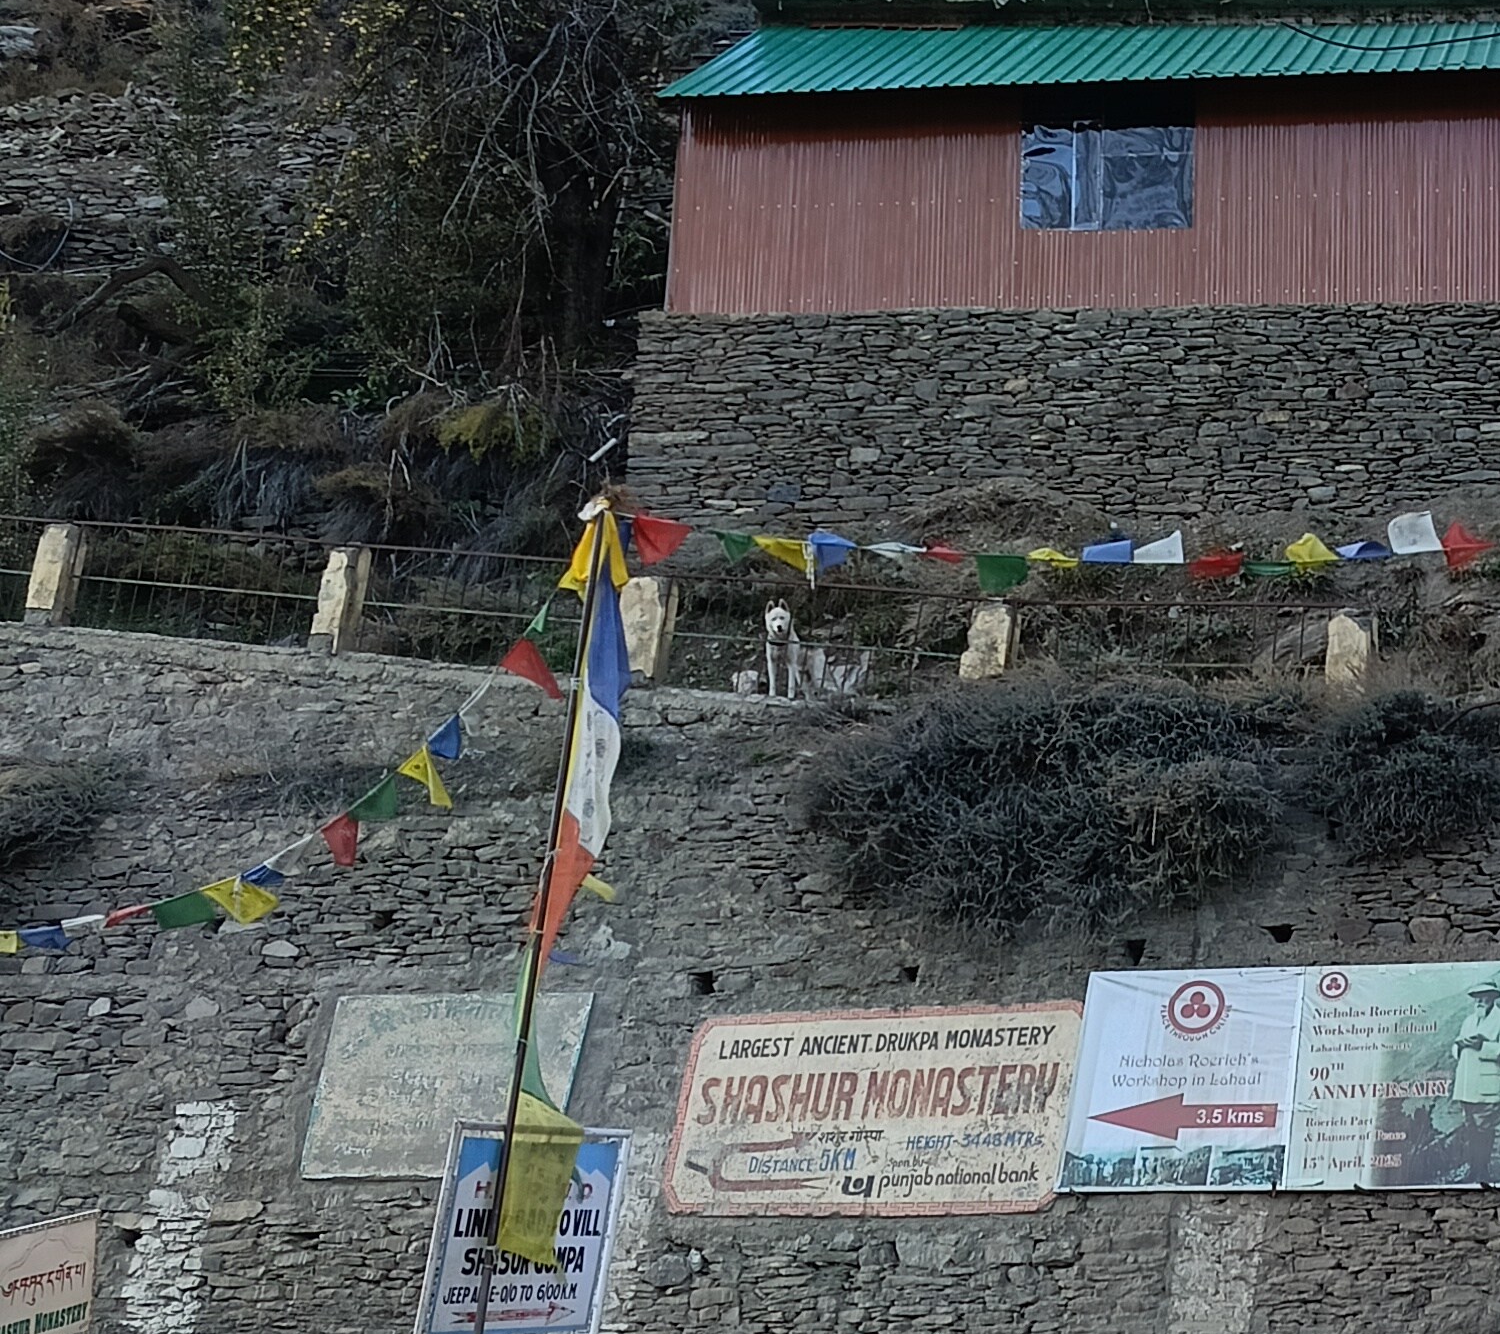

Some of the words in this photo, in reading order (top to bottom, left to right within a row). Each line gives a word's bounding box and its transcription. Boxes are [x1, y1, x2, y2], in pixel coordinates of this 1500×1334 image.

[1312, 1006, 1366, 1019] Nicholas
[1312, 1023, 1374, 1038] Workshop
[1377, 1023, 1390, 1034] in
[1394, 1020, 1438, 1033] Lahaul
[718, 1037, 795, 1060] LARGEST
[799, 1033, 872, 1057] ANCIENT
[875, 1030, 938, 1053] DRUKPA
[945, 1025, 1056, 1050] MONASTERY
[1344, 1042, 1379, 1052] Roerich
[1119, 1053, 1184, 1069] Nicholas
[1111, 1072, 1188, 1089] Workshop
[1191, 1072, 1205, 1087] in
[1209, 1070, 1262, 1086] Lahaul
[697, 1071, 858, 1126] SHASHUR
[862, 1062, 1060, 1119] MONASTERY
[1308, 1079, 1453, 1100] ANNIVERSARY
[1196, 1108, 1224, 1124] 3.5
[1226, 1107, 1265, 1124] kms
[1305, 1117, 1347, 1128] Roerich
[1304, 1132, 1313, 1142] &
[1317, 1132, 1356, 1142] Banner
[1358, 1130, 1372, 1141] of
[879, 1165, 933, 1199] punjab
[935, 1163, 996, 1186] national
[998, 1161, 1039, 1183] bank
[461, 1247, 531, 1276] SHSUR
[520, 1284, 533, 1302] TO
[34, 1301, 89, 1334] MONASTERY
